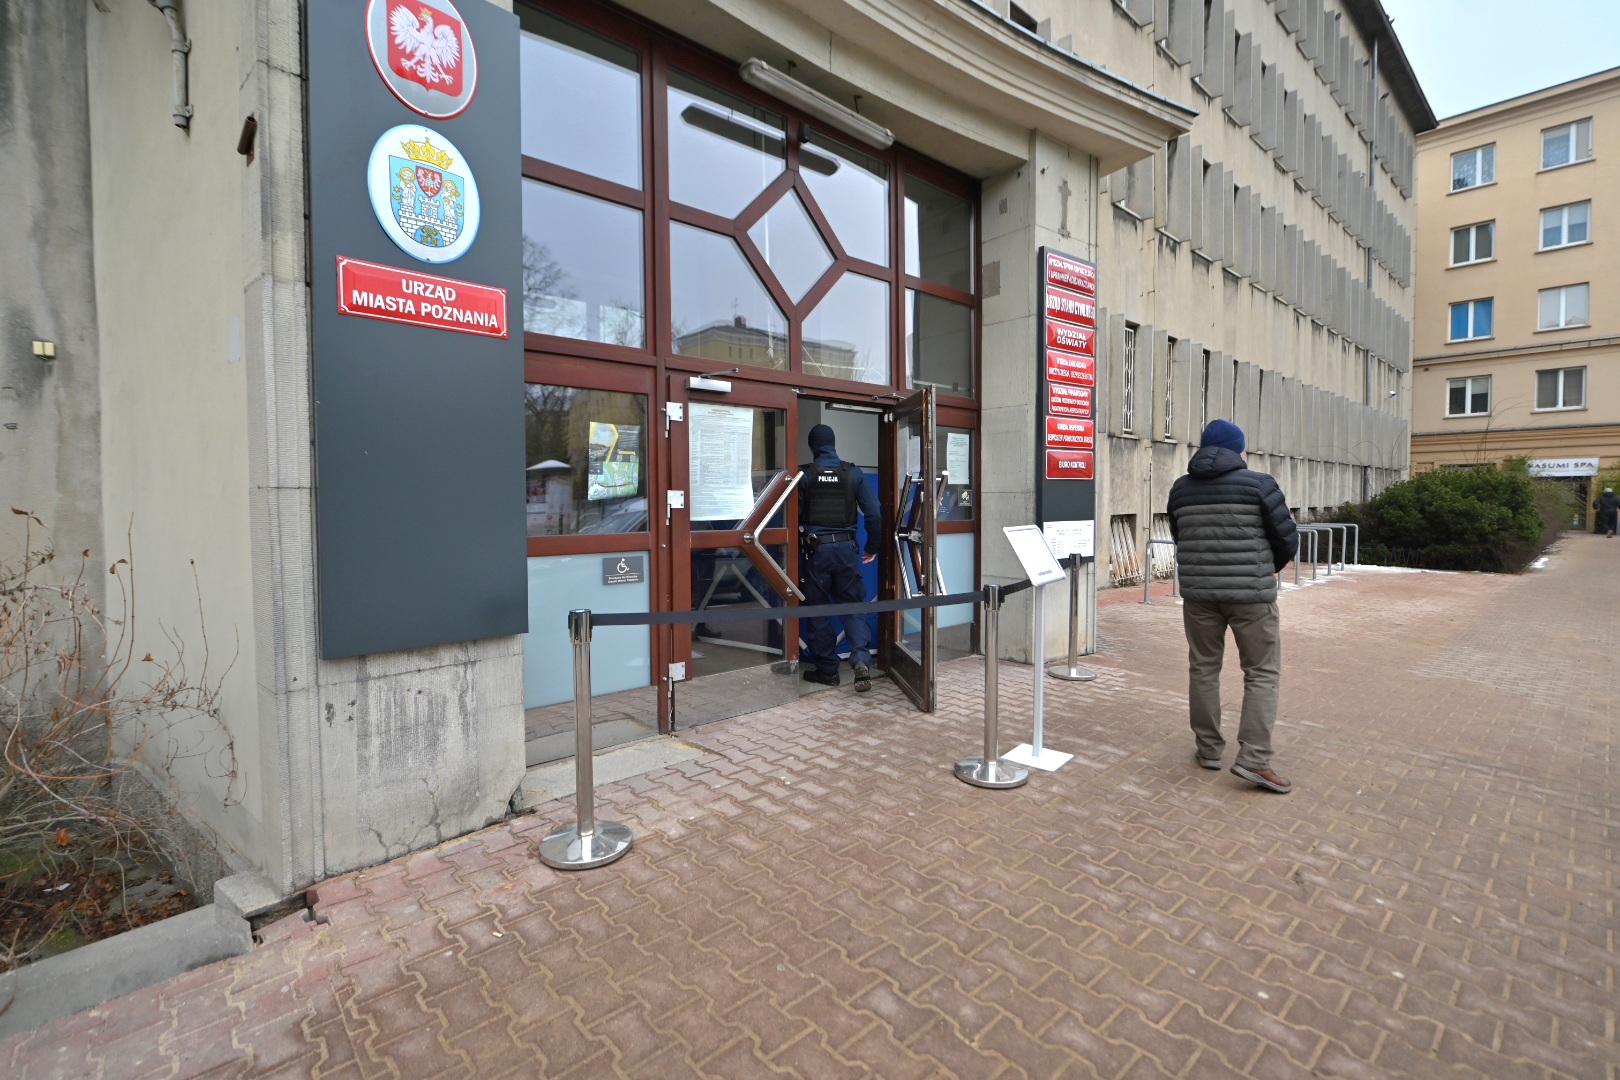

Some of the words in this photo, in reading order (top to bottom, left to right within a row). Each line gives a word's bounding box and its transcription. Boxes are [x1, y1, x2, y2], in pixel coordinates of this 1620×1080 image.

[401, 278, 457, 304] URZĄD
[352, 289, 416, 315] MIASTA
[421, 302, 499, 328] POZNANIA
[1056, 327, 1087, 341] WYDZIAŁ
[1056, 335, 1087, 349] OŚWIATY
